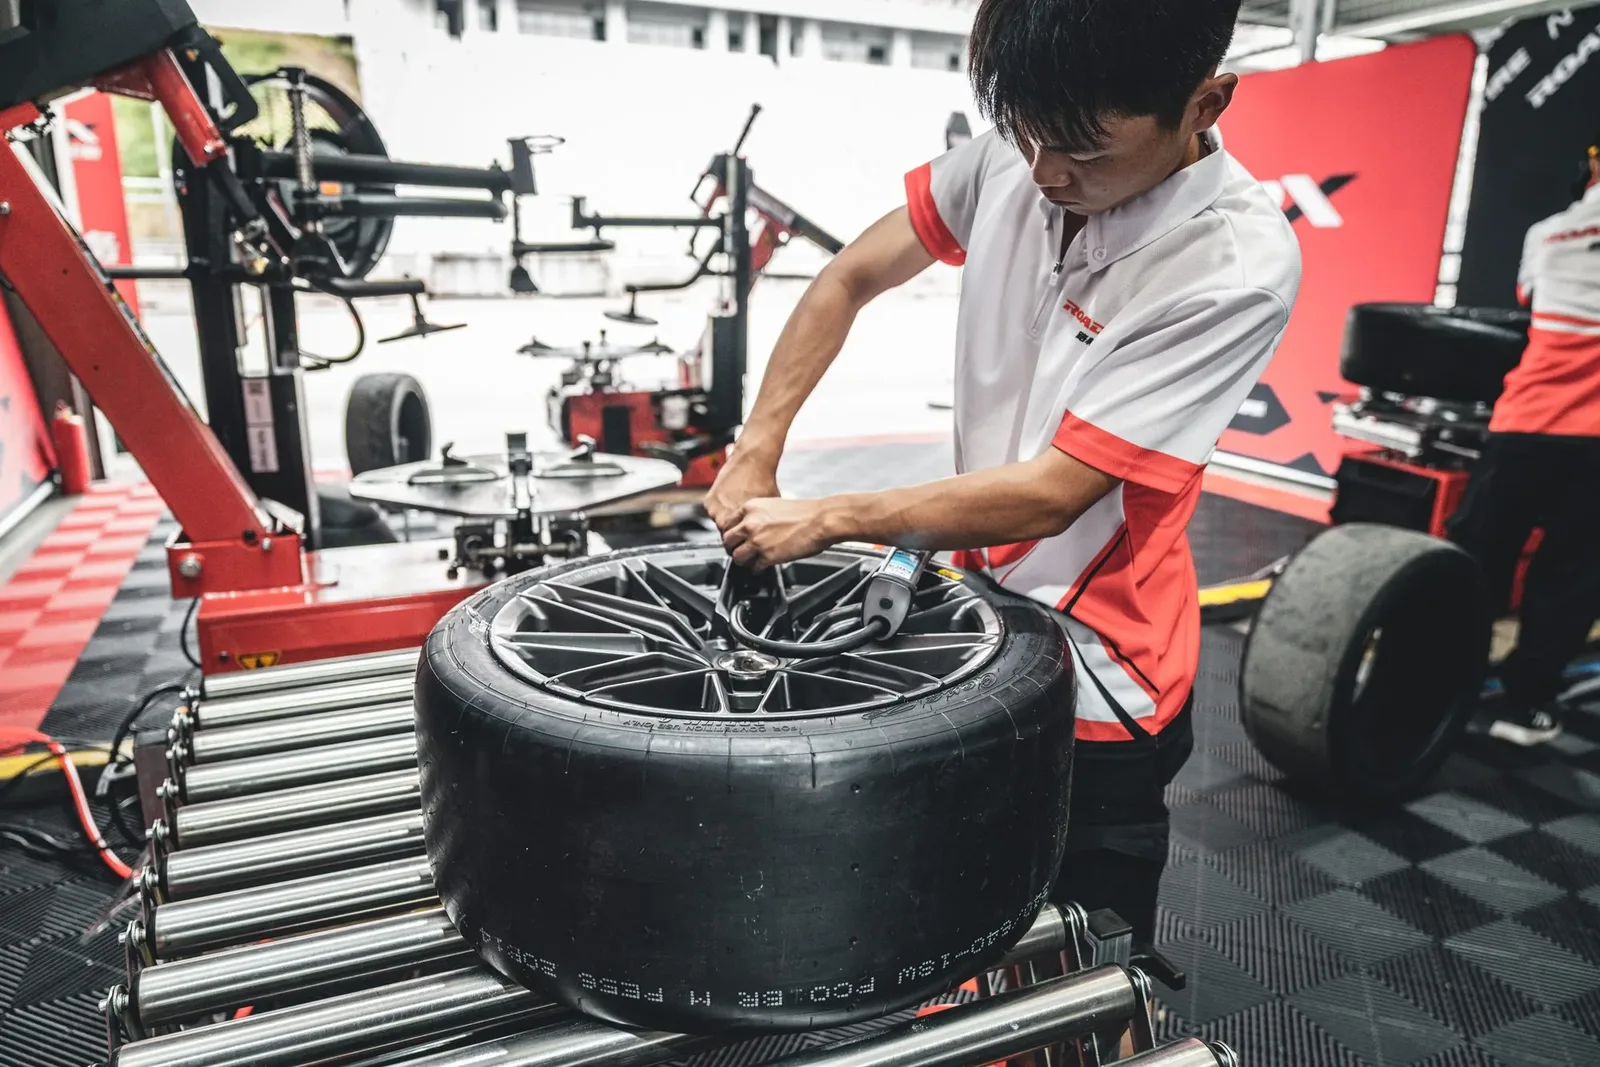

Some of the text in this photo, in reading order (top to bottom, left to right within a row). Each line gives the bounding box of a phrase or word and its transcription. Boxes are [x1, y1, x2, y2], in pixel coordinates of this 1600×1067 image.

[1525, 23, 1600, 109] ROA
[657, 723, 681, 731] USE
[772, 725, 799, 733] FOR
[690, 990, 711, 1006] M
[737, 990, 783, 1007] BR
